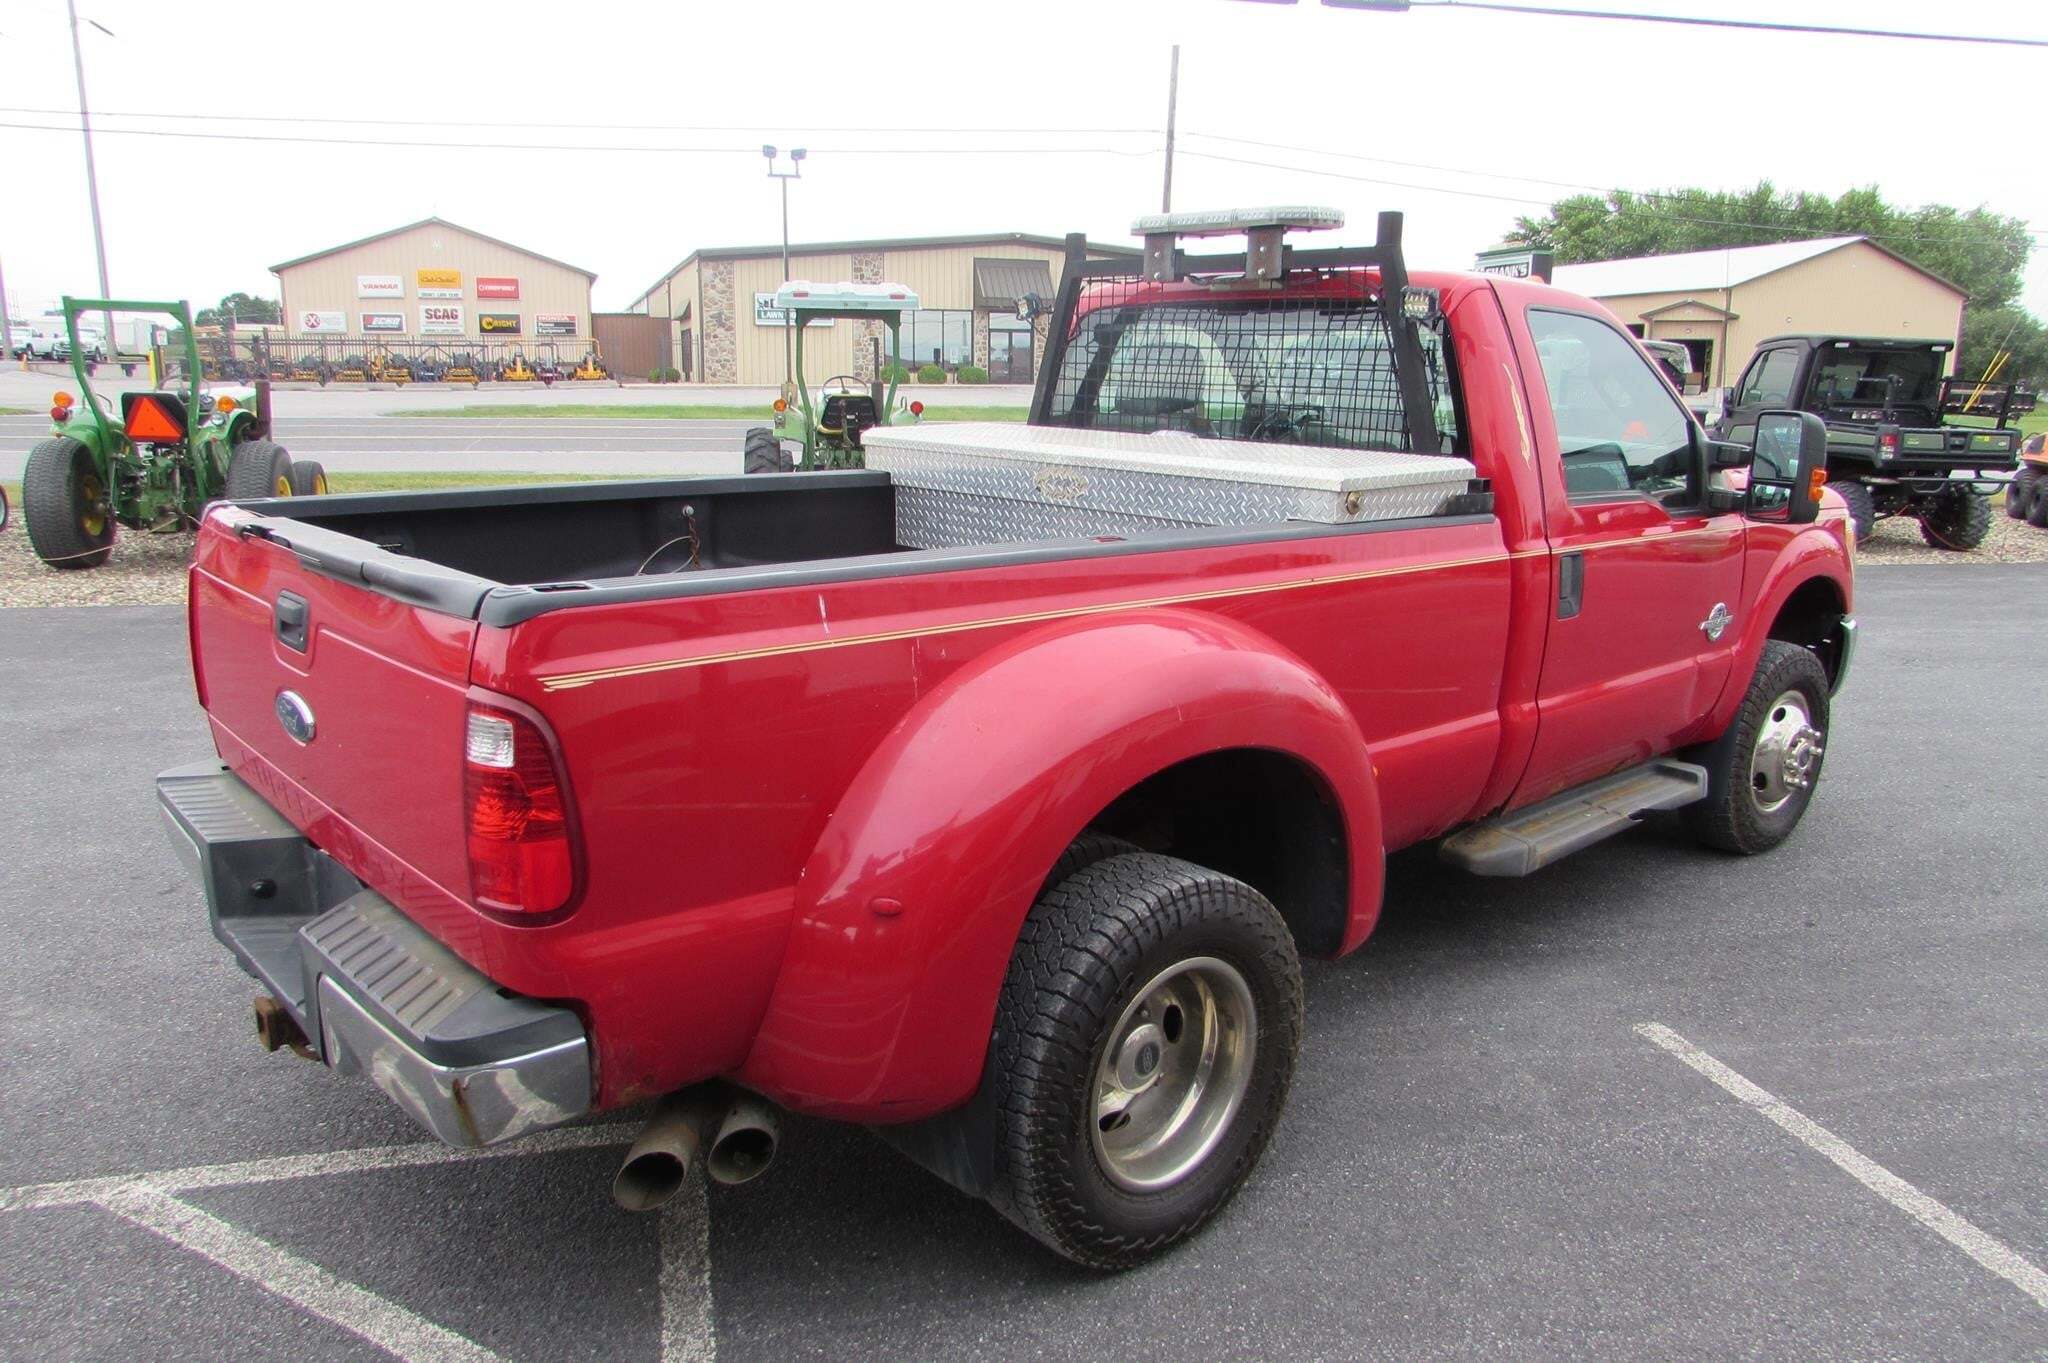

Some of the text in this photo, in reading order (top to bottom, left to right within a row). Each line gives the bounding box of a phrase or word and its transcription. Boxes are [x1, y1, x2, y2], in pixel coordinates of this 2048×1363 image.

[424, 308, 459, 320] SCAG
[761, 311, 784, 319] LAWN
[481, 317, 518, 330] WRIGHT
